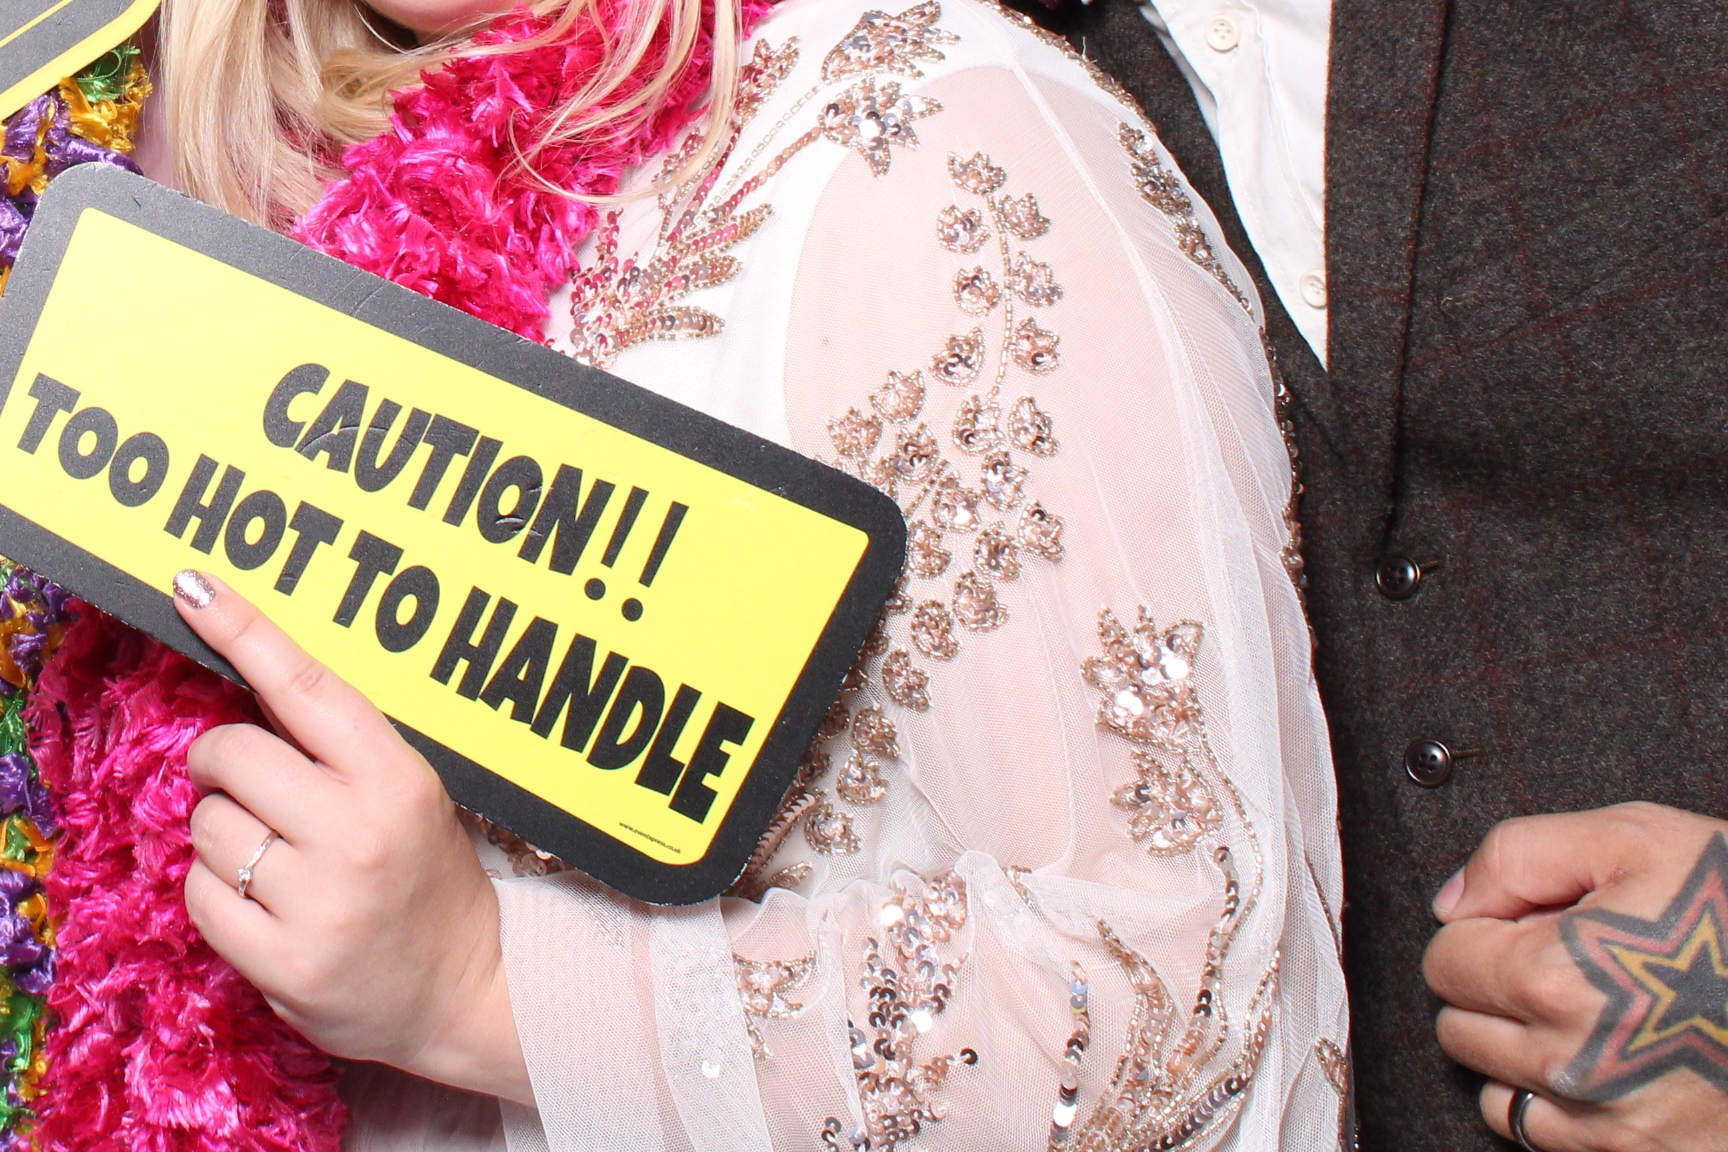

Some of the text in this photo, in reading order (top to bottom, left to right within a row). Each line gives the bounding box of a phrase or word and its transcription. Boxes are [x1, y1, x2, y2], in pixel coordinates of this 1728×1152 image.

[16, 372, 756, 825] TOO HOT TO HANDLE
[262, 362, 690, 623] CAUTION!!
